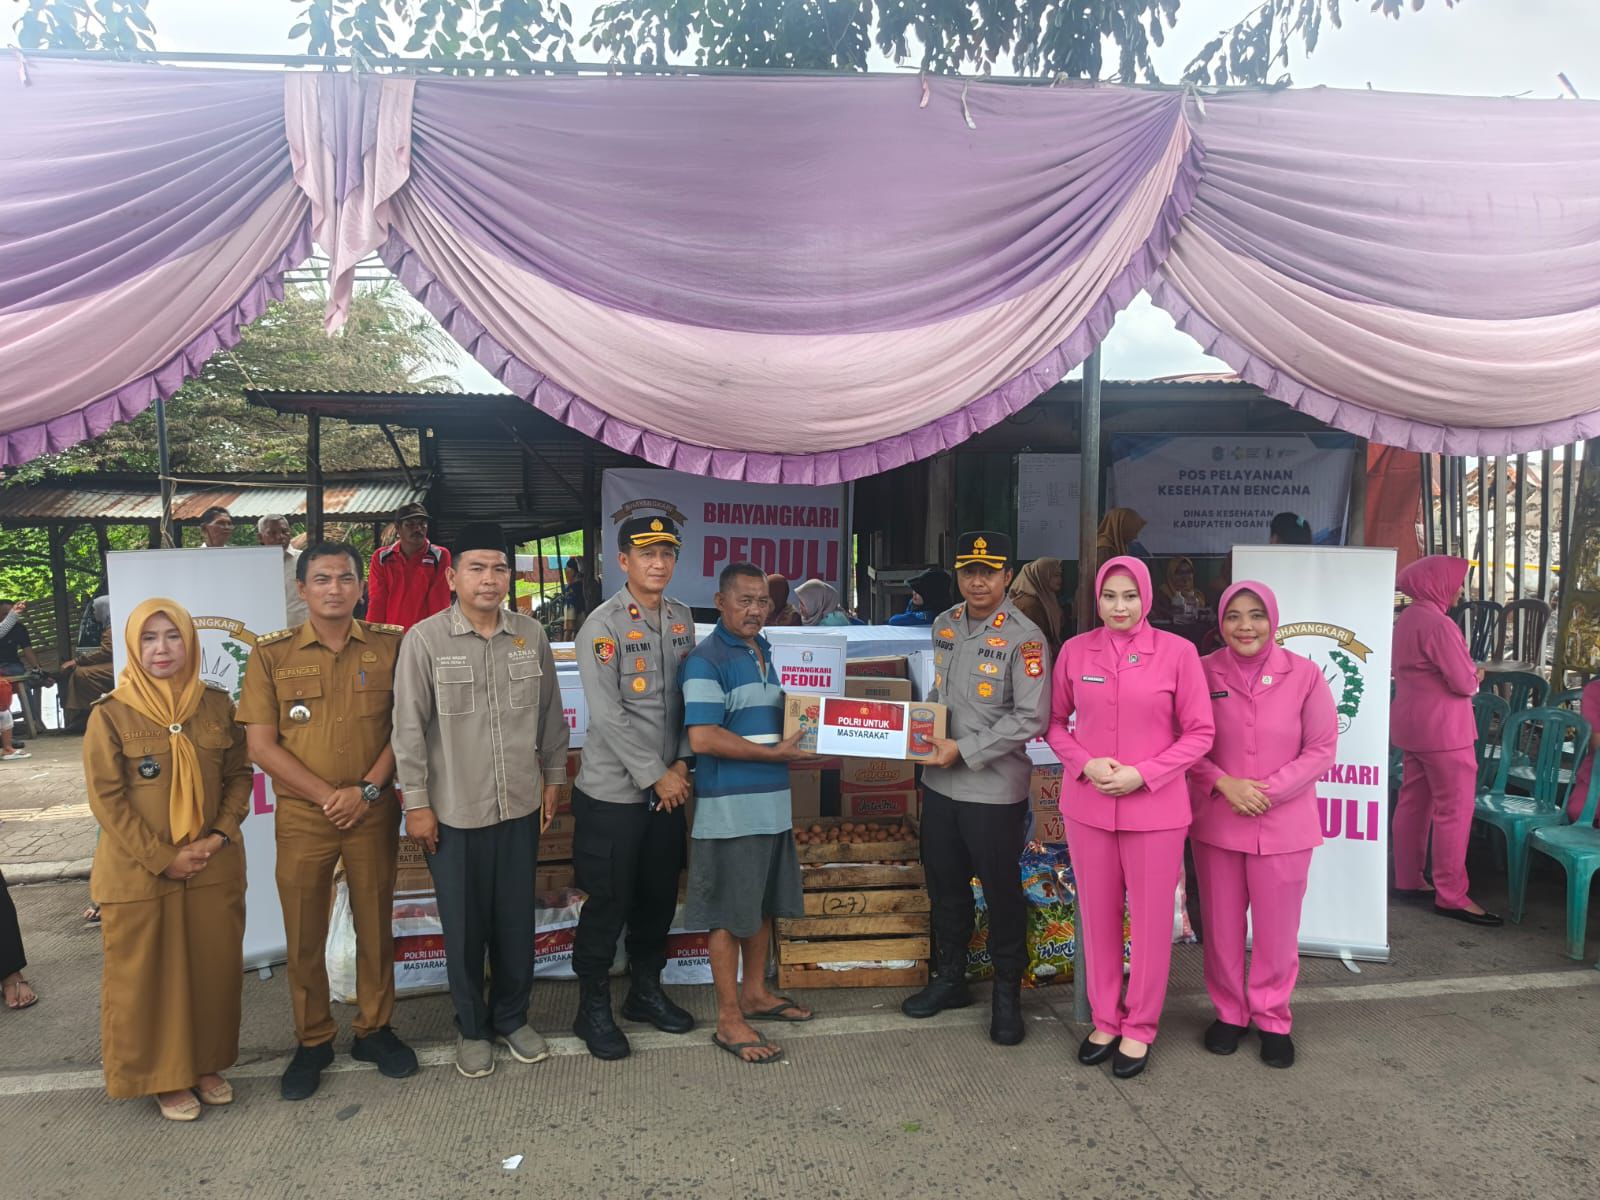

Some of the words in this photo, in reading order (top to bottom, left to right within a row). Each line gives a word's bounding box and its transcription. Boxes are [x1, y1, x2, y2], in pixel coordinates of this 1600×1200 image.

[1179, 470, 1206, 481] POS
[1210, 470, 1293, 481] PELAYANAN
[1158, 485, 1240, 496] KESEHATAN
[1243, 485, 1311, 496] BENCANA
[703, 502, 839, 528] BHAYANGKARI
[1184, 510, 1213, 518] DINAS
[1216, 510, 1274, 518] KESEHATAN
[1173, 520, 1232, 529] KABUPATEN
[1234, 520, 1264, 529] OGAN
[702, 535, 839, 582] PEDULI
[192, 618, 240, 632] ANGKARI
[1274, 623, 1349, 641] BHAYANGKARI
[625, 642, 651, 654] HELMI
[977, 647, 1008, 662] POLRI
[781, 666, 832, 674] BHAYANGKARI
[781, 674, 832, 688] PEDULI
[838, 716, 861, 727] POLRI
[863, 718, 890, 729] UNTUK
[837, 728, 890, 740] MASYARAKAT
[404, 950, 427, 960] POLRI
[677, 948, 699, 957] POLRI
[677, 957, 710, 967] MASYARA
